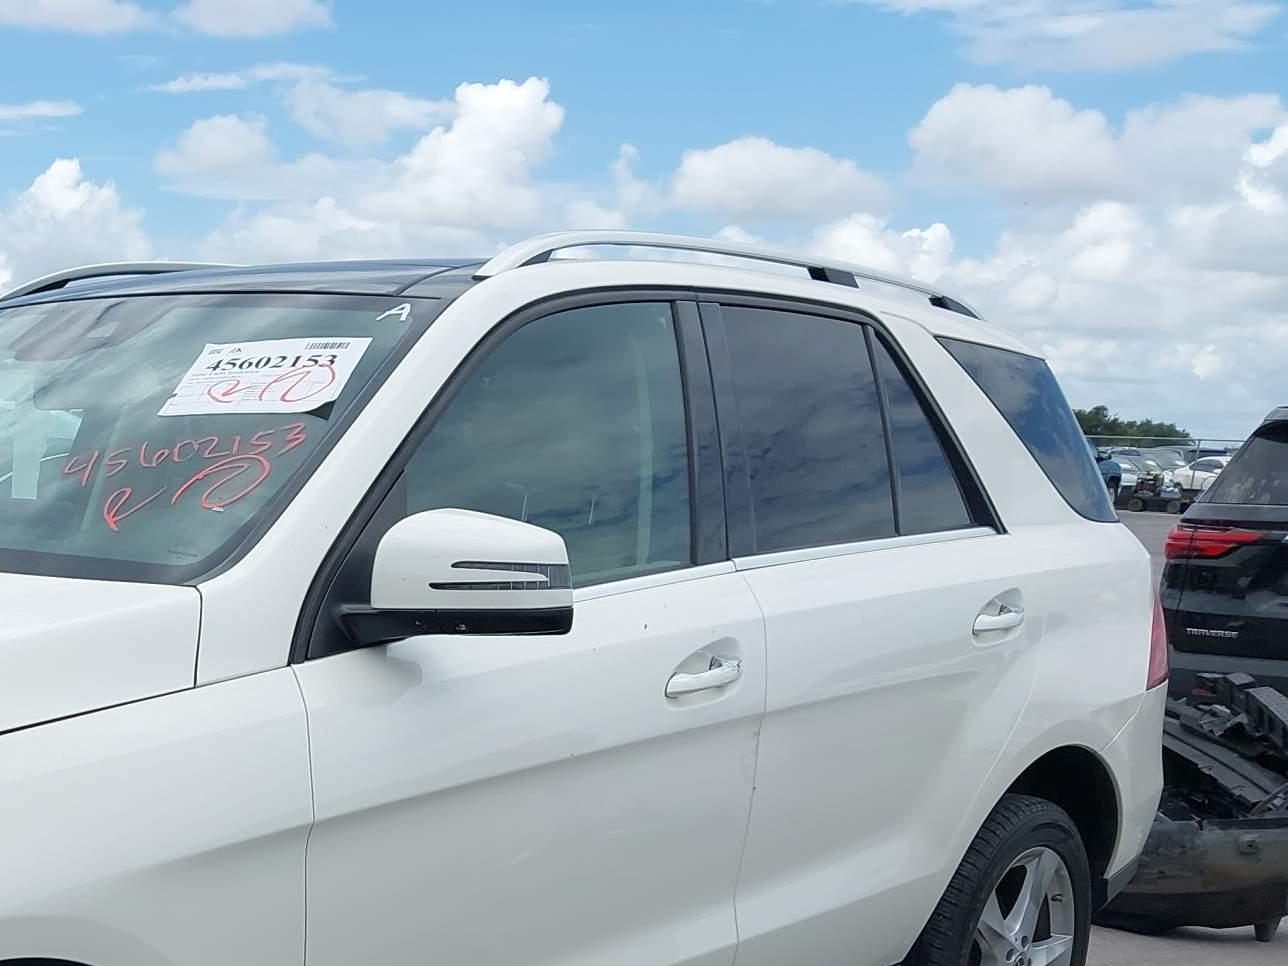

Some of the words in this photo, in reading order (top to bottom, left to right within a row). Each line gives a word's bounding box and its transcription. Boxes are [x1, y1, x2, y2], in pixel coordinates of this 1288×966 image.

[206, 354, 338, 372] 45602153
[63, 422, 308, 487] 45602153
[1185, 627, 1239, 639] TRAVERSE
